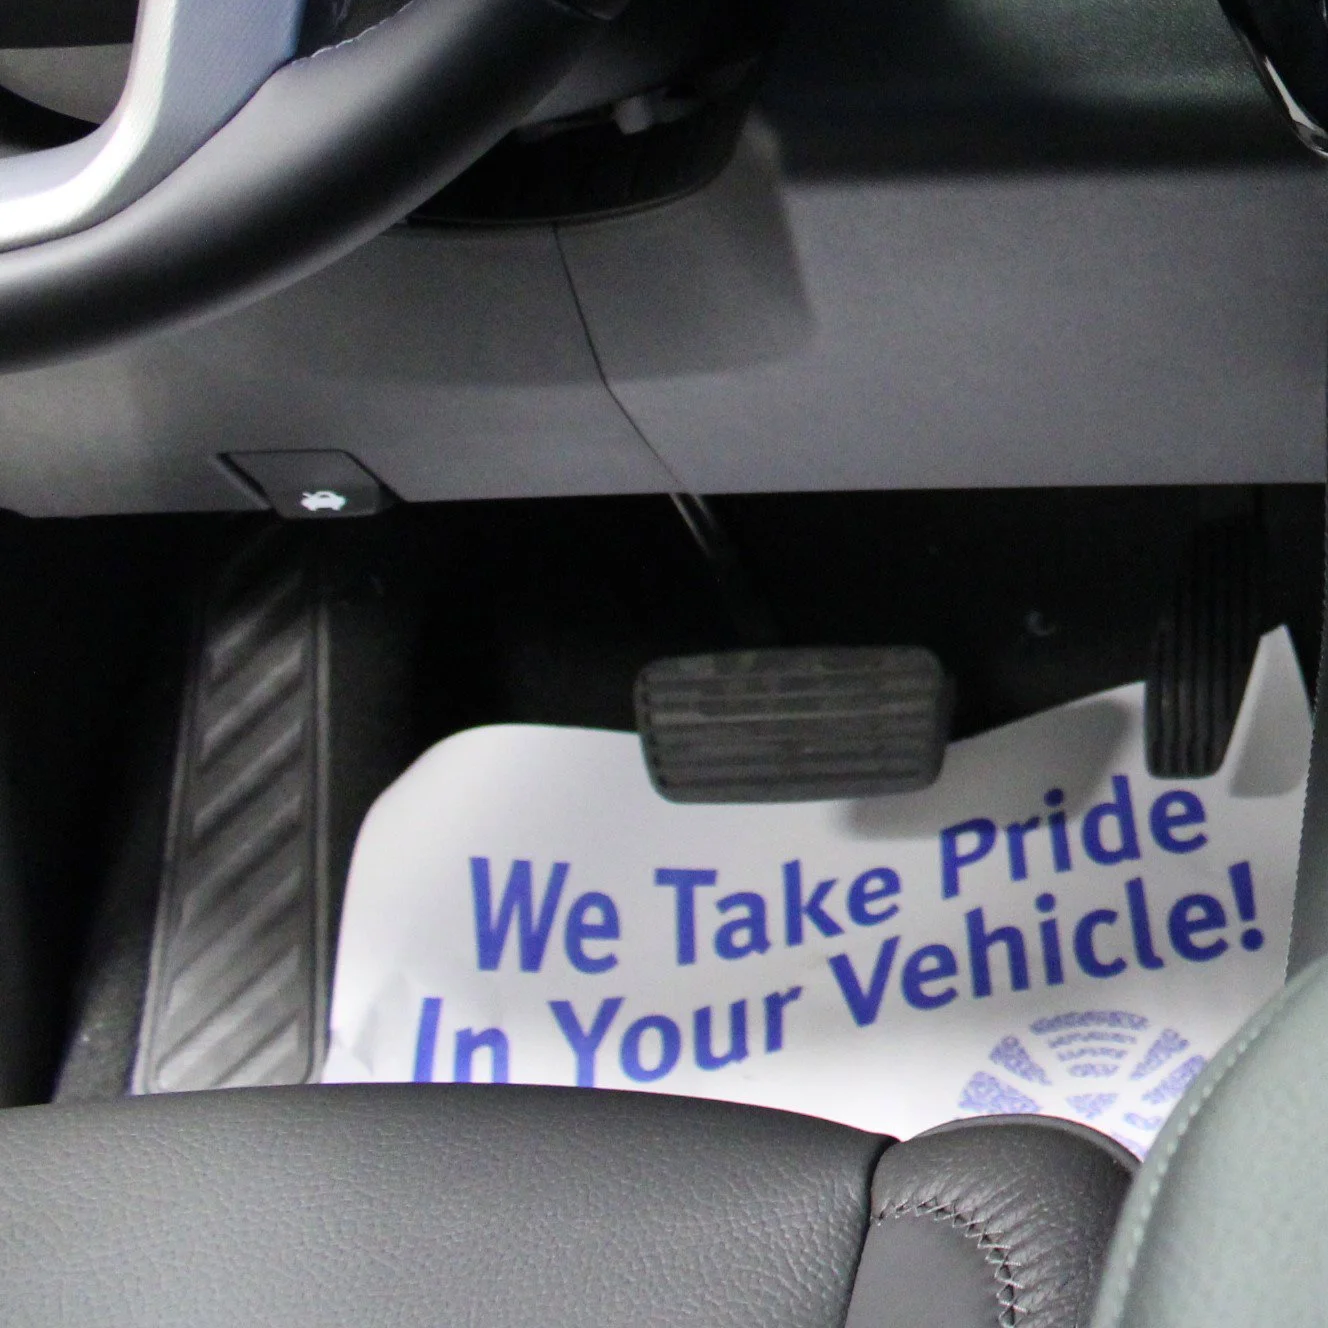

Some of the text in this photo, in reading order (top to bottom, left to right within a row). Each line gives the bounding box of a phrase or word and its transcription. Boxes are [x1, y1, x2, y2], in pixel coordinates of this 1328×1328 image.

[412, 859, 1266, 1089] In Your Vehicle!
[470, 773, 1209, 976] We Take Pride
